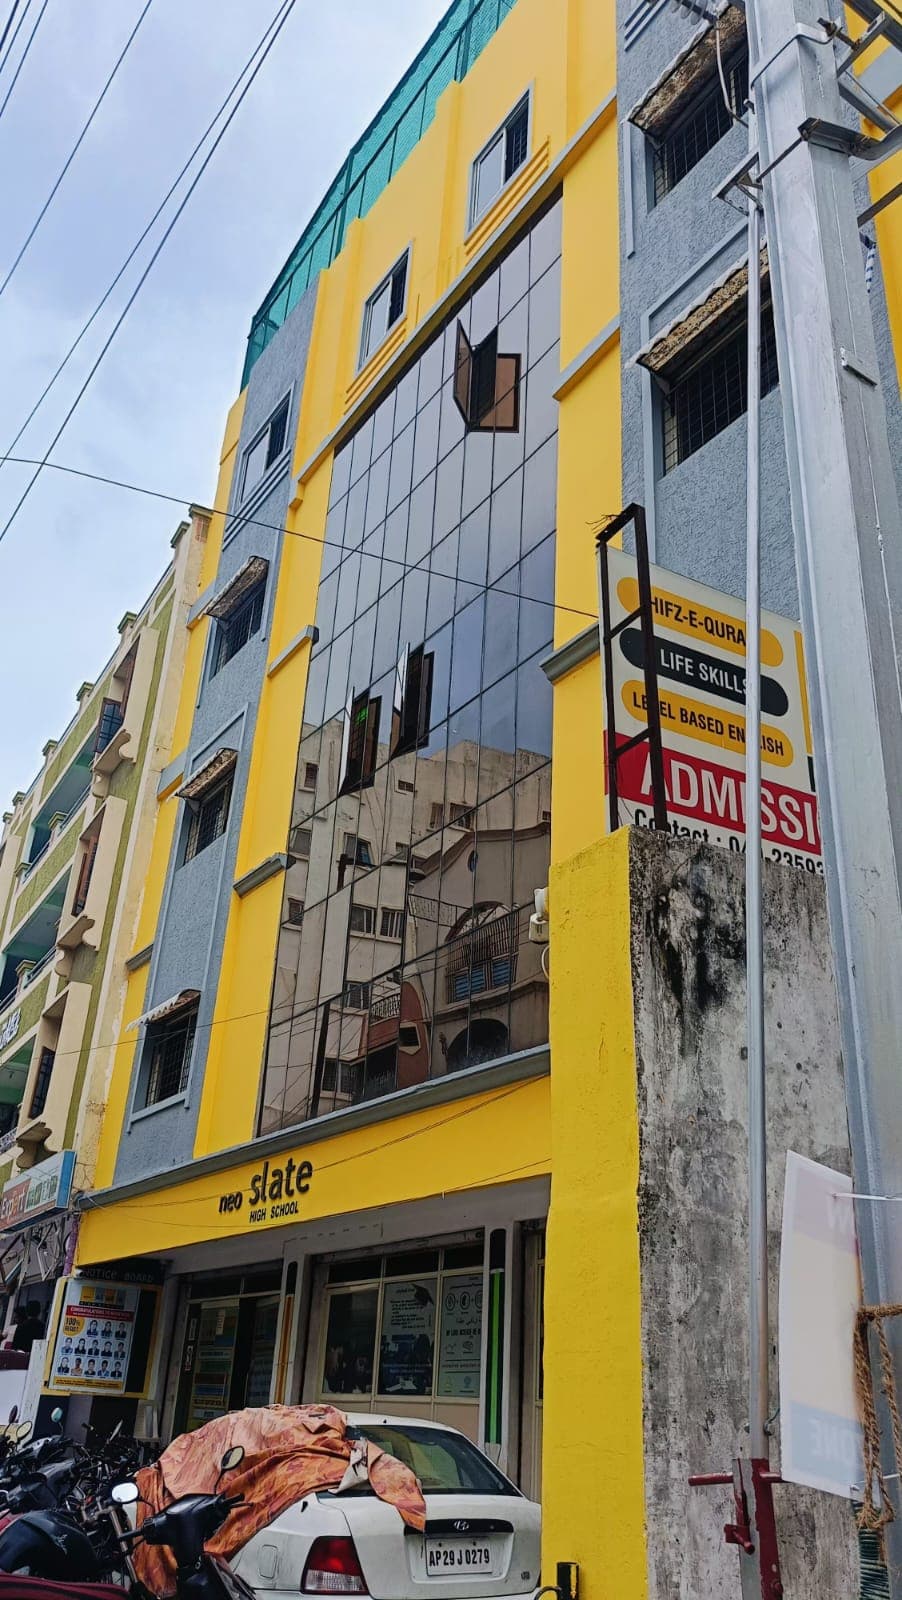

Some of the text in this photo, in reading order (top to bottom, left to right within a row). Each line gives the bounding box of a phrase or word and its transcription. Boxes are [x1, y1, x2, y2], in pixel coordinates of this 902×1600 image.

[650, 596, 746, 647] HIFZ-E-QURA
[660, 648, 694, 676] LIFE
[633, 691, 784, 756] LEEL BASED ENISH
[640, 751, 821, 845] ADMISSI
[218, 1157, 313, 1213] neo slate
[249, 1200, 299, 1223] HIGH SCHOOL
